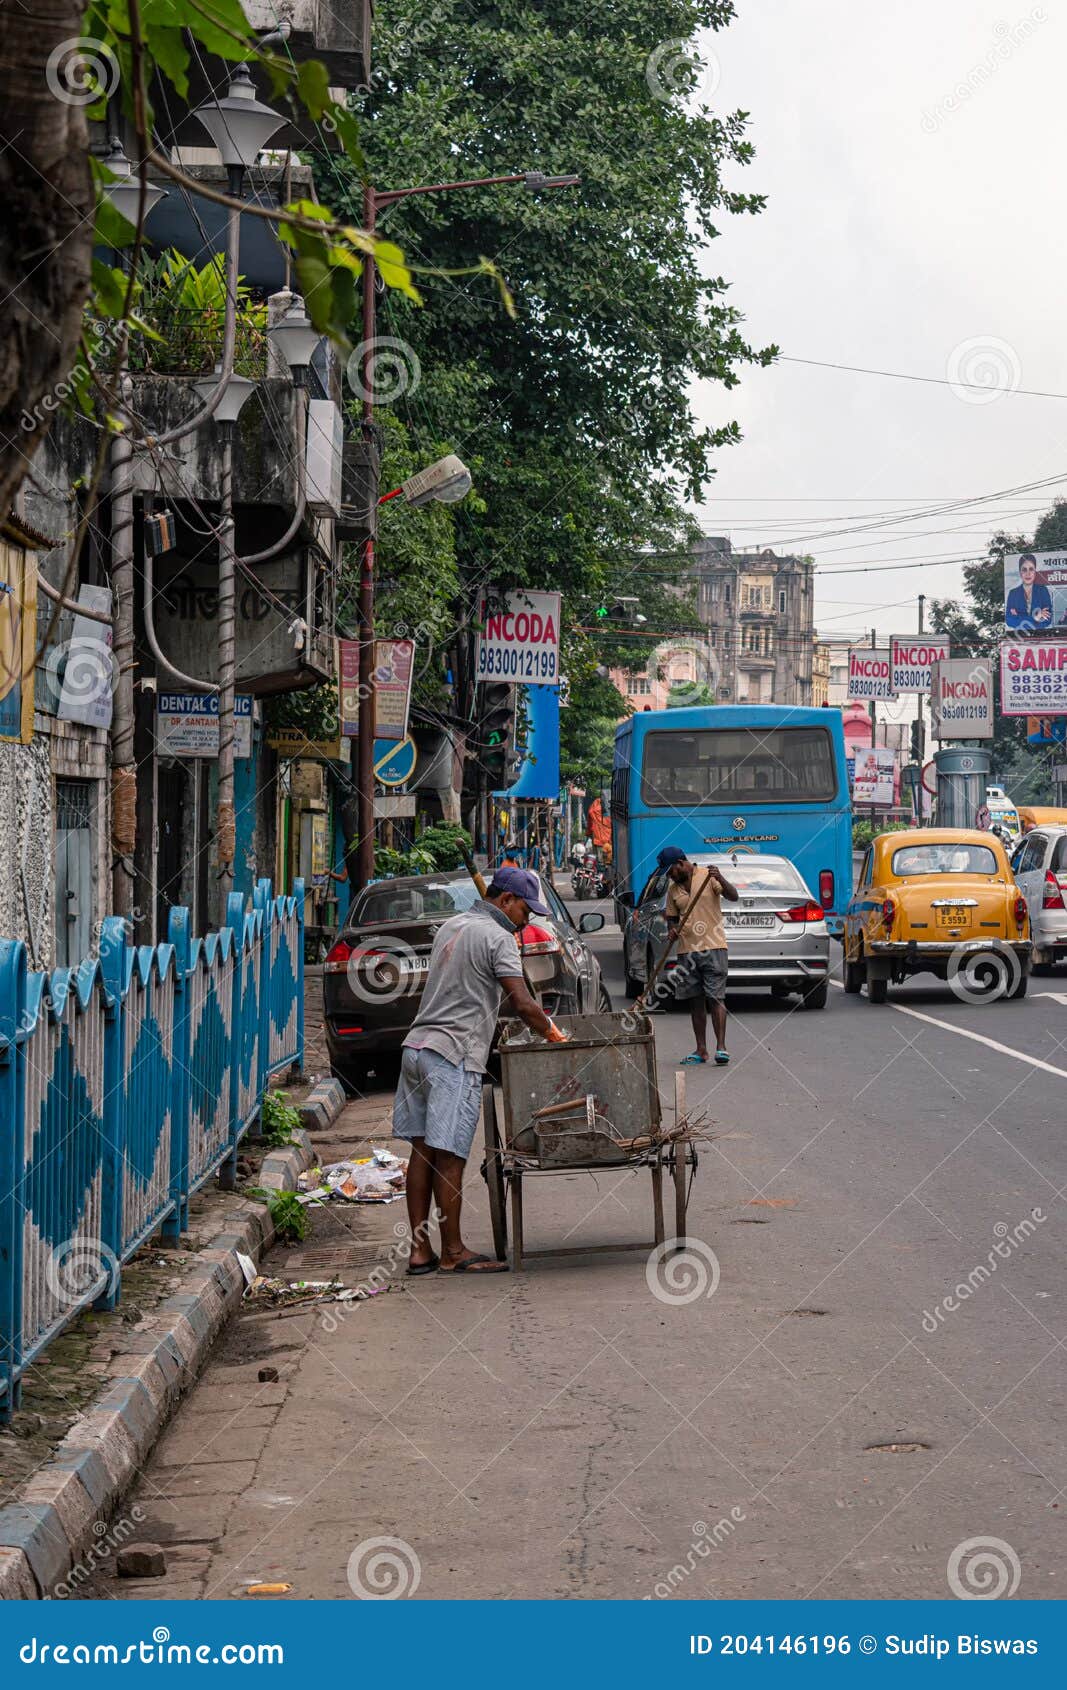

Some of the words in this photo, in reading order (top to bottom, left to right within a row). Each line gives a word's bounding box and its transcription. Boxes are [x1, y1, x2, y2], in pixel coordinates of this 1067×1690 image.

[479, 648, 556, 678] 9830012199
[850, 654, 889, 678] INCOD
[893, 670, 932, 687] 9830012
[161, 696, 207, 711] DENTAL
[210, 698, 250, 713] CIC
[941, 705, 988, 719] 9830012199
[955, 907, 965, 915] 25
